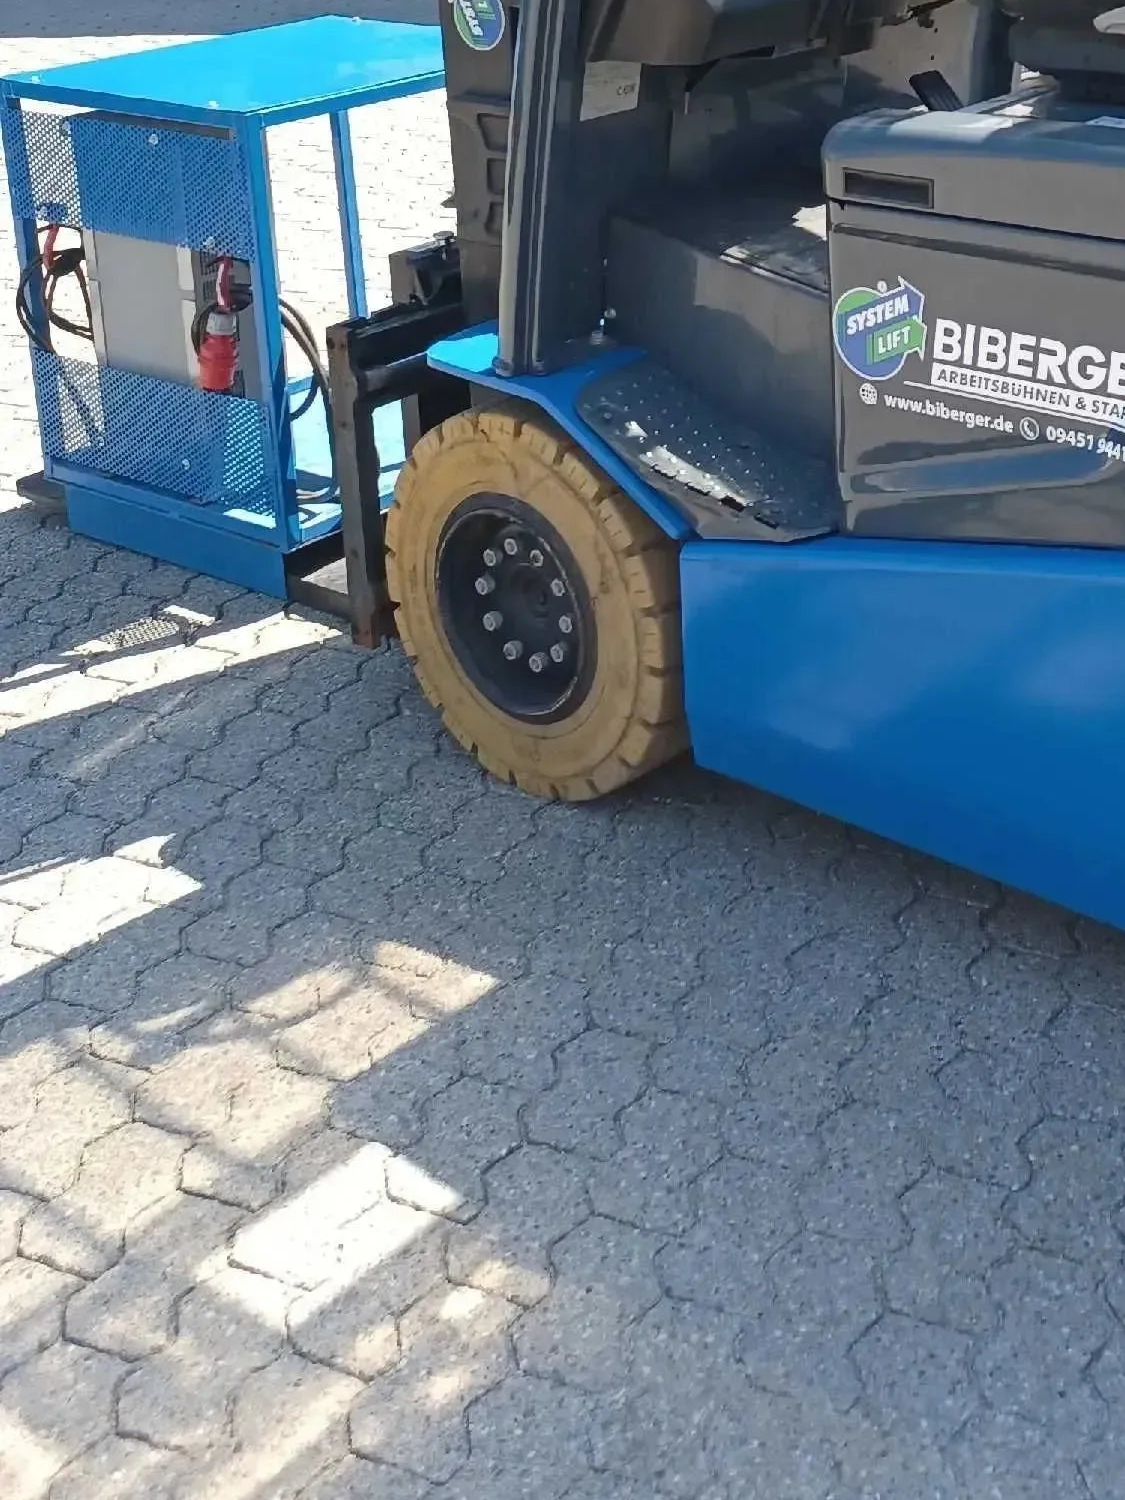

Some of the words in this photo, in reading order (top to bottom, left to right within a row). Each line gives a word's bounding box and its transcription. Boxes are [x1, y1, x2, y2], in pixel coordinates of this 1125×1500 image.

[846, 293, 909, 335] SYSTEM
[878, 326, 911, 354] LIFT
[937, 368, 1071, 408] ARBEITSBÜHNEN
[1075, 396, 1087, 411] &
[884, 394, 1014, 433] www.biberger.de
[1046, 425, 1094, 450] 09451
